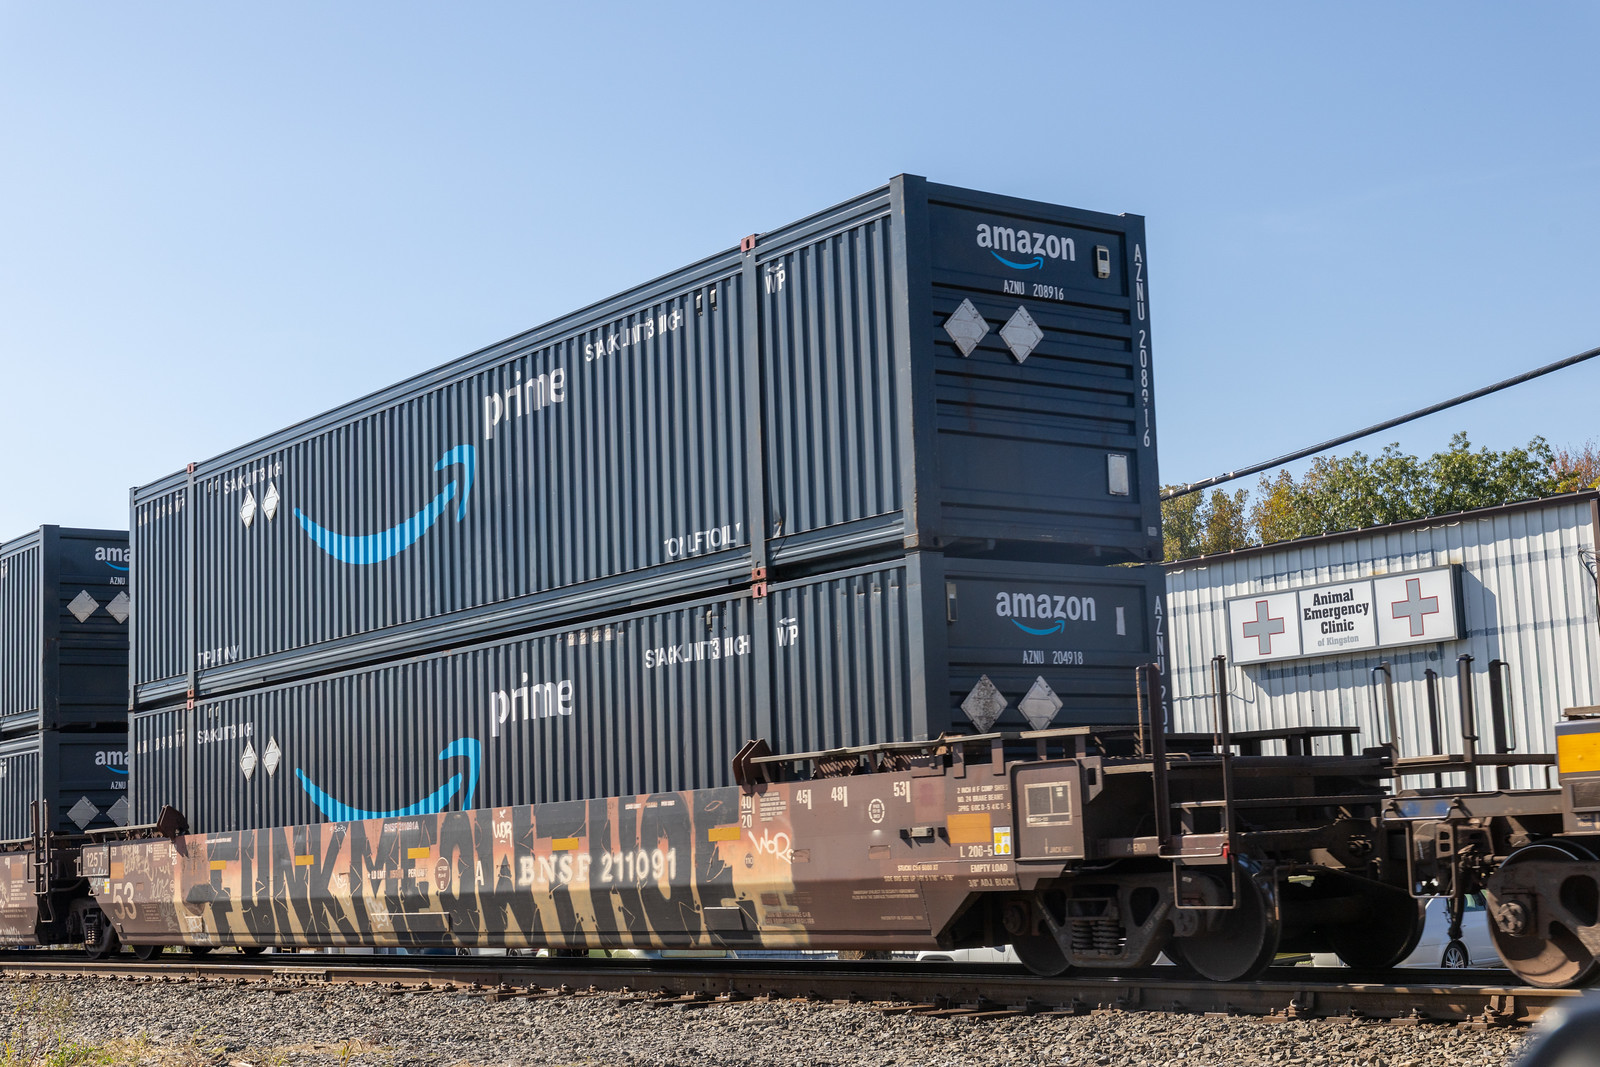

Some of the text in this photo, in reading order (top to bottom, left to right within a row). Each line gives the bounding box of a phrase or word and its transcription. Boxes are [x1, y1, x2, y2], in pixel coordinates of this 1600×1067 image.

[976, 223, 1076, 262] amazon
[1004, 280, 1064, 300] AZNU 208916
[1134, 244, 1145, 321] AZNU
[484, 367, 565, 440] prime
[110, 576, 126, 586] AZNU
[1312, 588, 1354, 606] Animal
[996, 591, 1096, 622] amazon
[1303, 602, 1370, 622] Emergency
[1320, 618, 1354, 635] Clinic
[1154, 595, 1165, 676] AZNU
[1317, 634, 1360, 648] of Kingston
[1022, 650, 1083, 665] AZNU 204918
[490, 672, 573, 738] prime
[796, 790, 808, 804] 45
[831, 786, 843, 802] 48
[893, 782, 906, 796] 53
[740, 796, 752, 810] 40
[384, 822, 398, 832] BNSF
[741, 814, 752, 828] 20
[86, 852, 98, 868] 125
[99, 852, 104, 867] T
[960, 846, 966, 858] L
[408, 869, 416, 878] PER
[475, 860, 484, 886] A
[518, 847, 677, 886] BNSF 211091
[970, 864, 1008, 873] EMPTY LOAD
[995, 878, 1016, 886] BLOCK
[112, 882, 137, 920] 53
